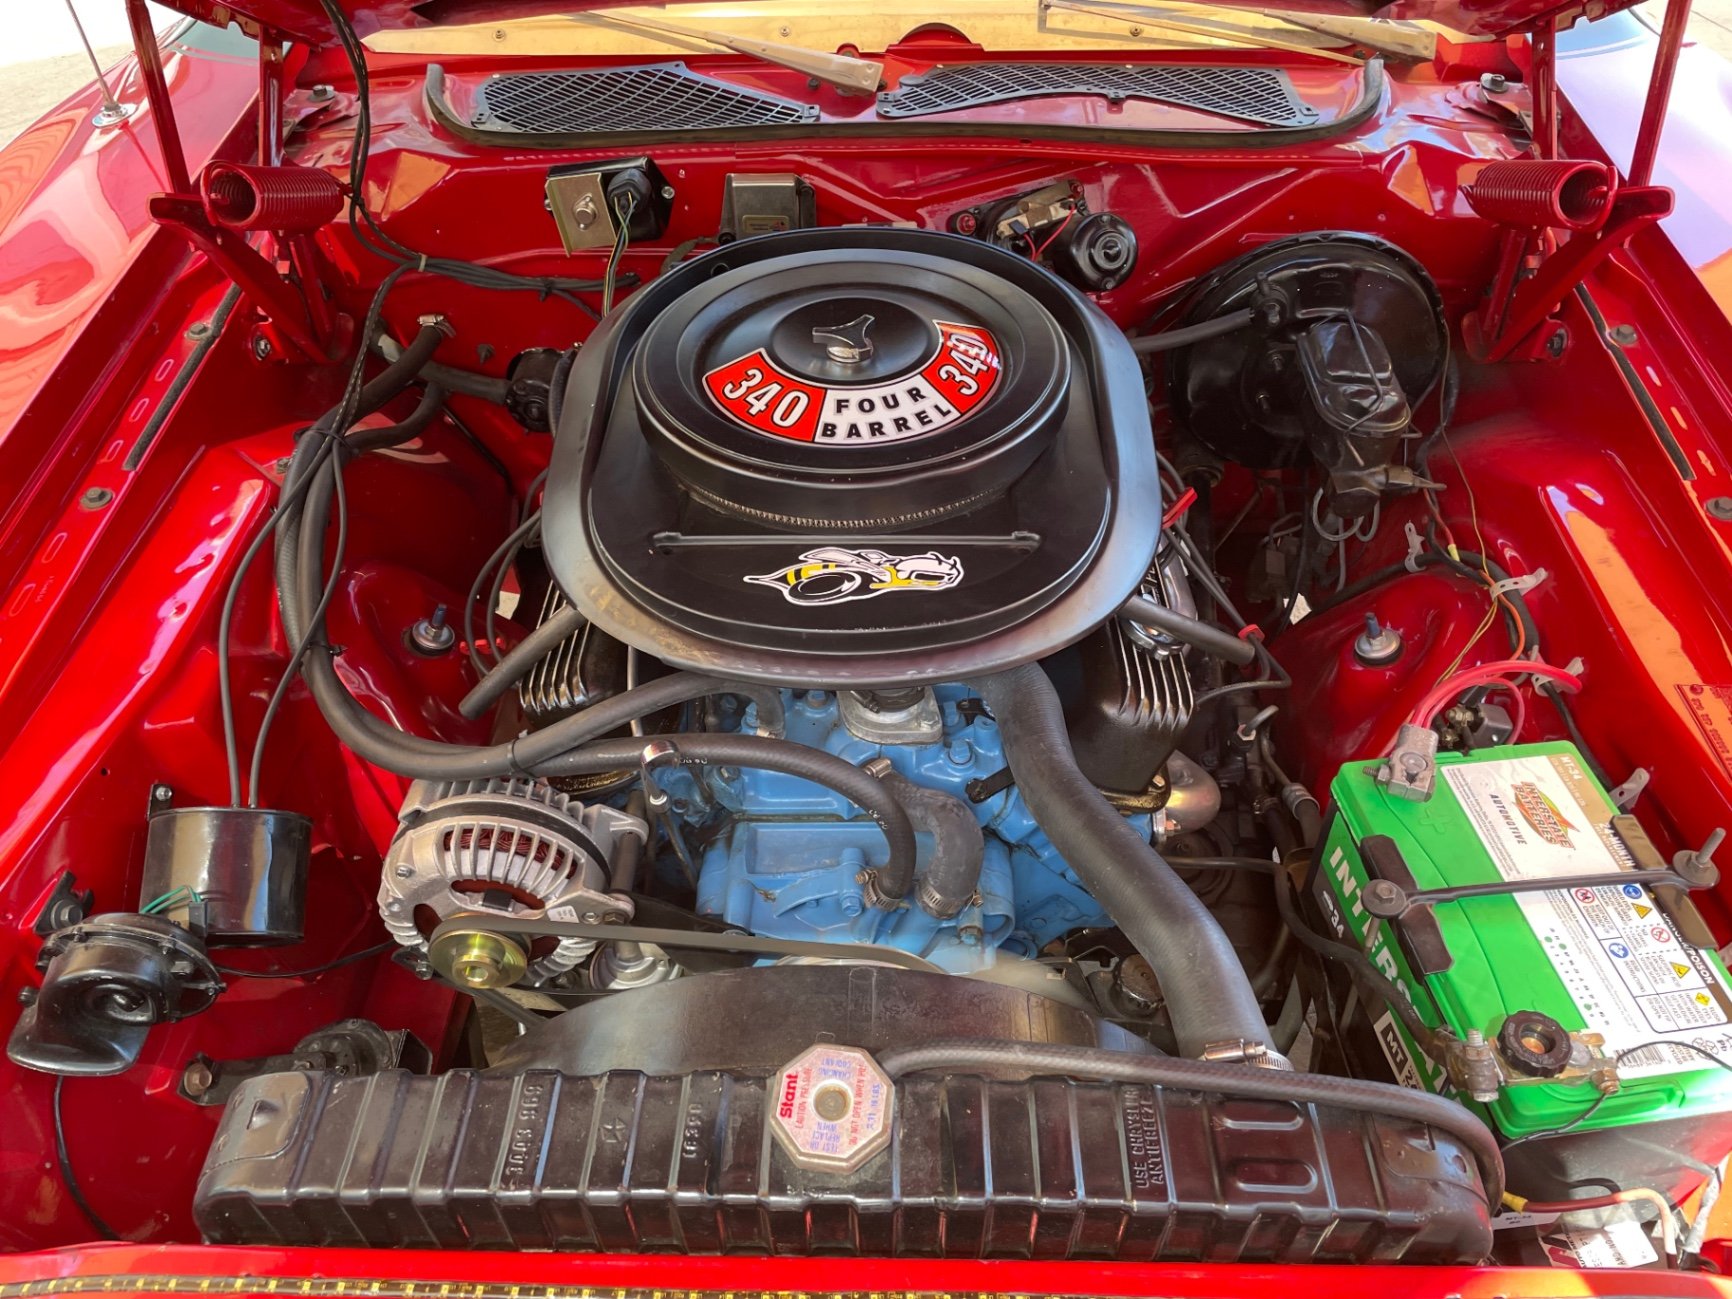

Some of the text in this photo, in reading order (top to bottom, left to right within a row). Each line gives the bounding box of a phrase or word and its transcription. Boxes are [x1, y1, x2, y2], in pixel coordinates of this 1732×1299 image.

[936, 333, 990, 396] 340
[722, 367, 811, 429] 340
[821, 403, 954, 438] BARREL
[835, 386, 926, 413] FOUR
[1489, 794, 1528, 845] AUTOMOTIVE
[1515, 786, 1557, 844] BATTERIES
[1523, 782, 1571, 848] INTERSTATE
[1386, 1030, 1404, 1064] MT
[780, 1073, 798, 1119] Stant
[1124, 1087, 1149, 1188] USE CHRYSLER
[1140, 1100, 1164, 1184] ANTIFREEZE
